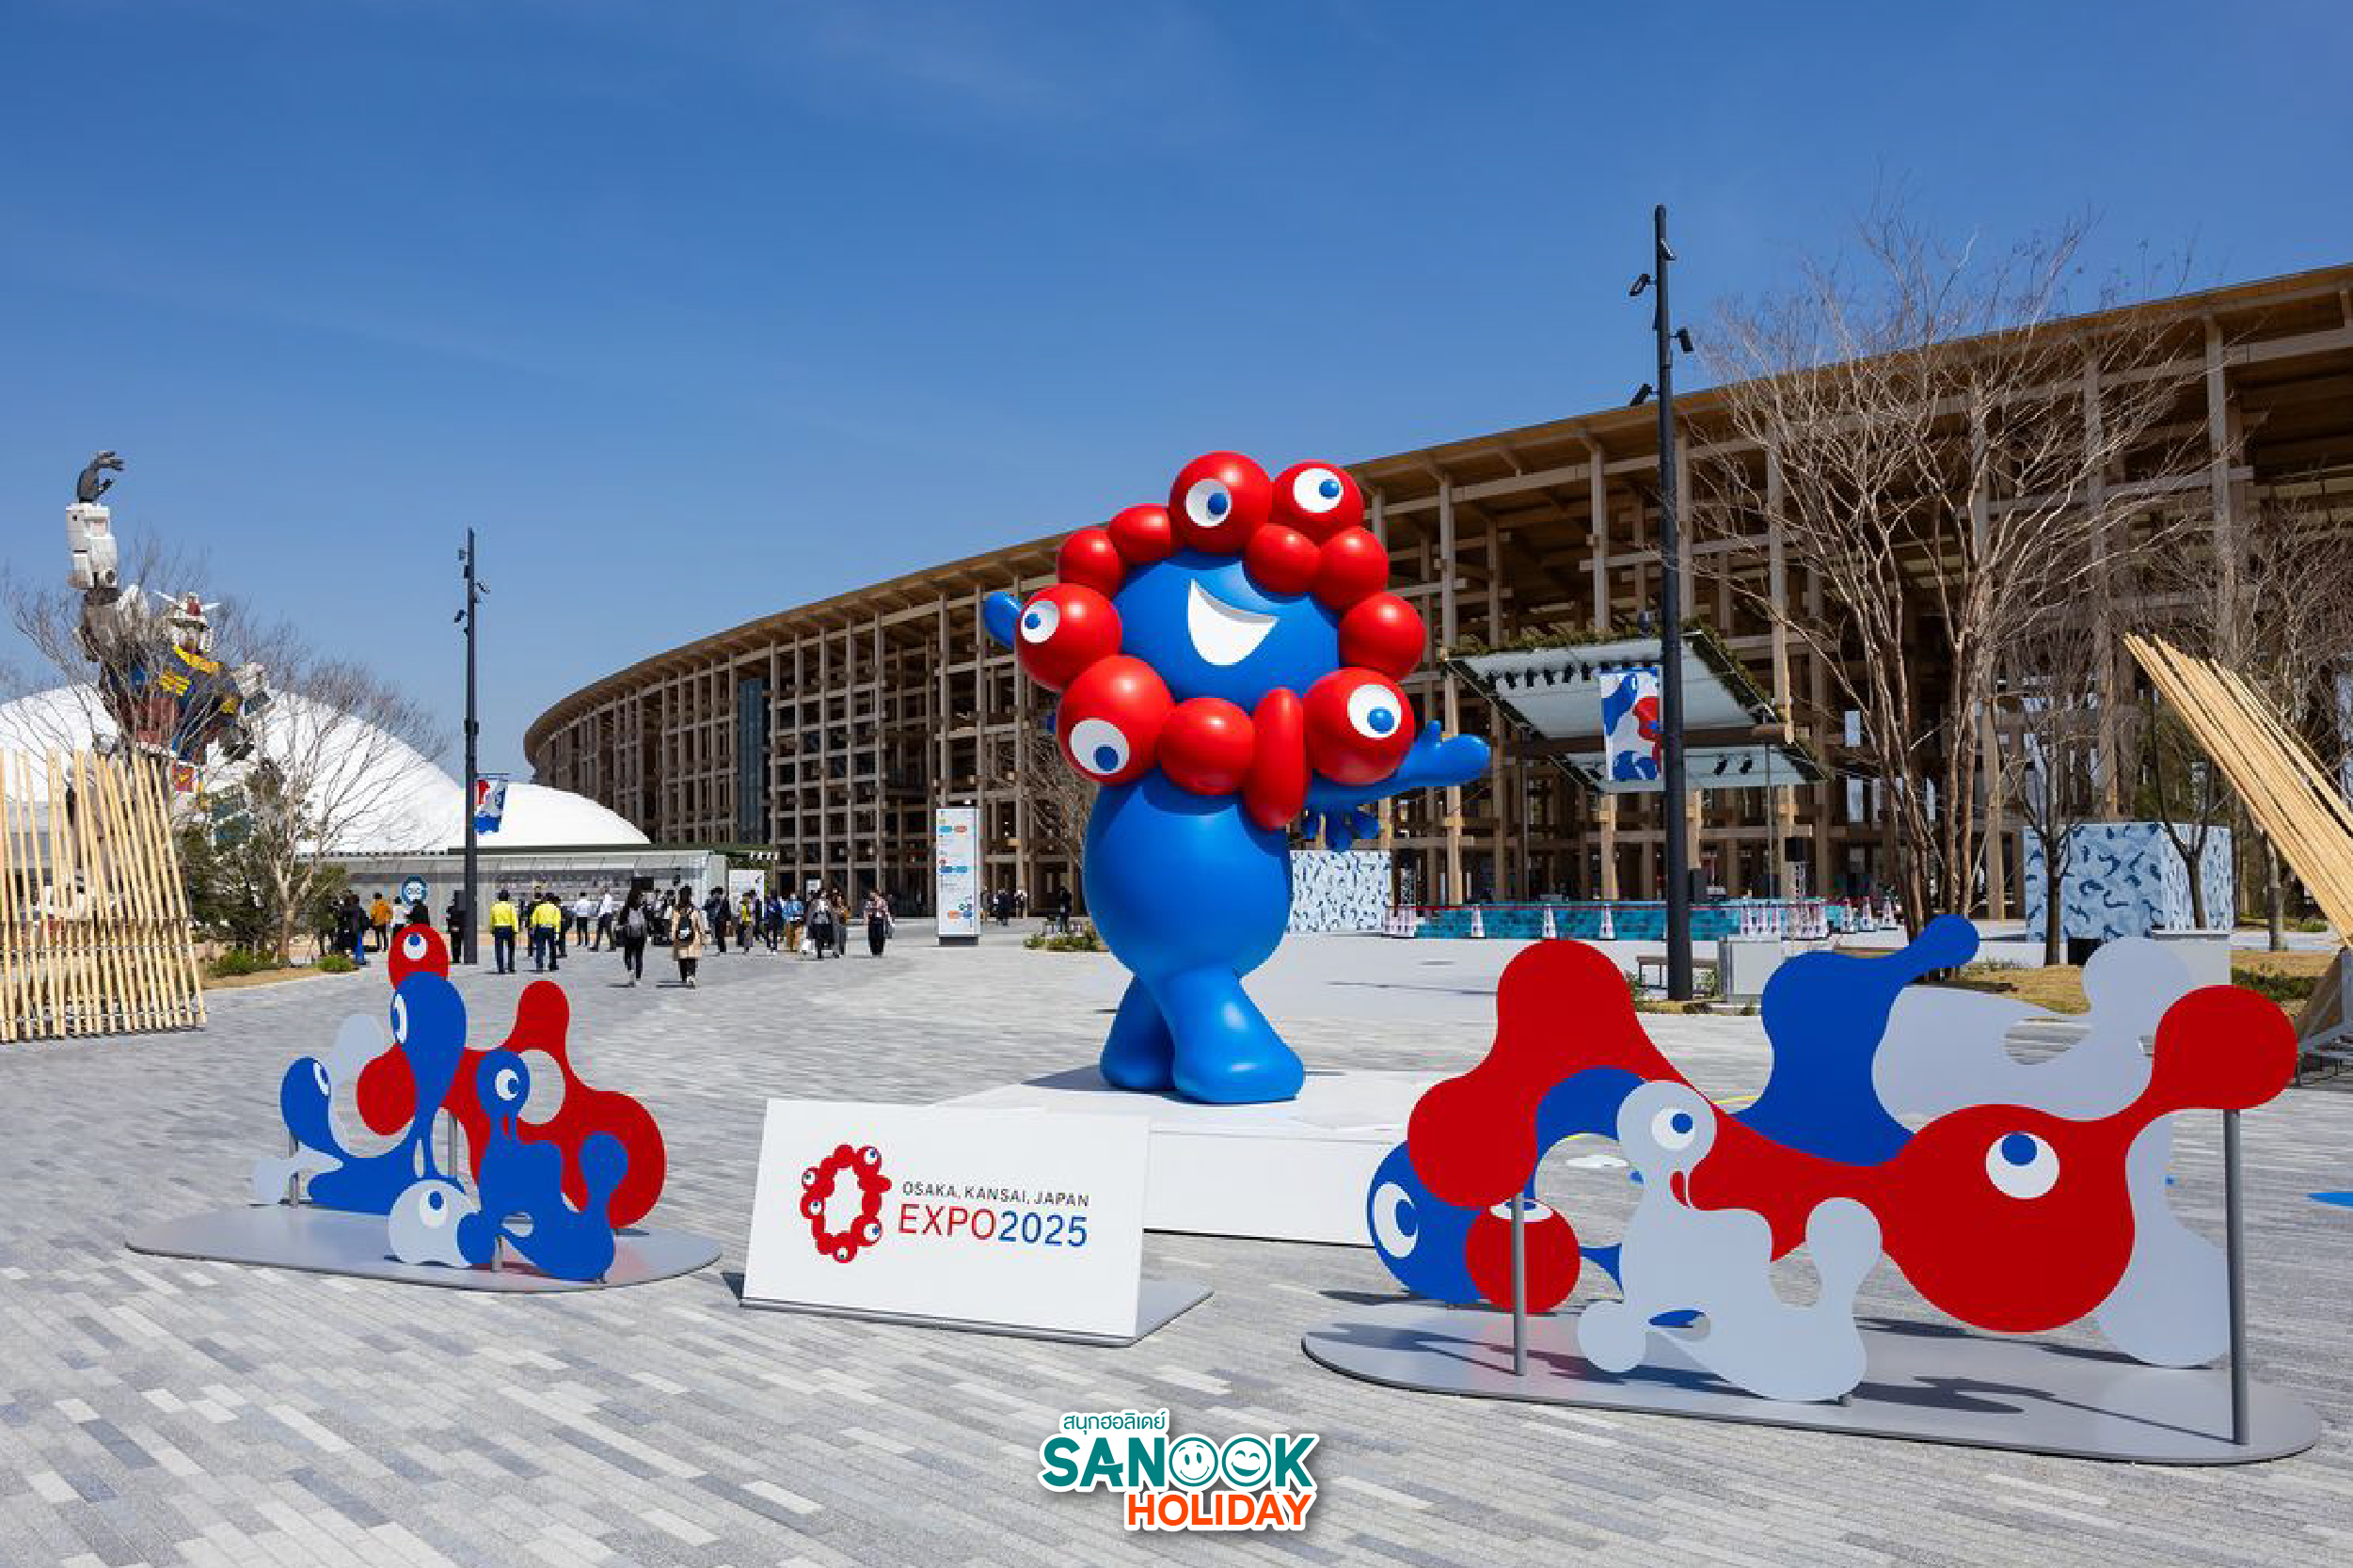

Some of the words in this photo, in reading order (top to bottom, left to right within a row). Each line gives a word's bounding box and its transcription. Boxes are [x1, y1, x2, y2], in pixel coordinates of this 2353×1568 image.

[902, 1181, 961, 1199] OSAKA,
[965, 1186, 1029, 1204] KANSAI,
[1034, 1192, 1089, 1206] JAPAN
[898, 1203, 1087, 1248] EXPO2025
